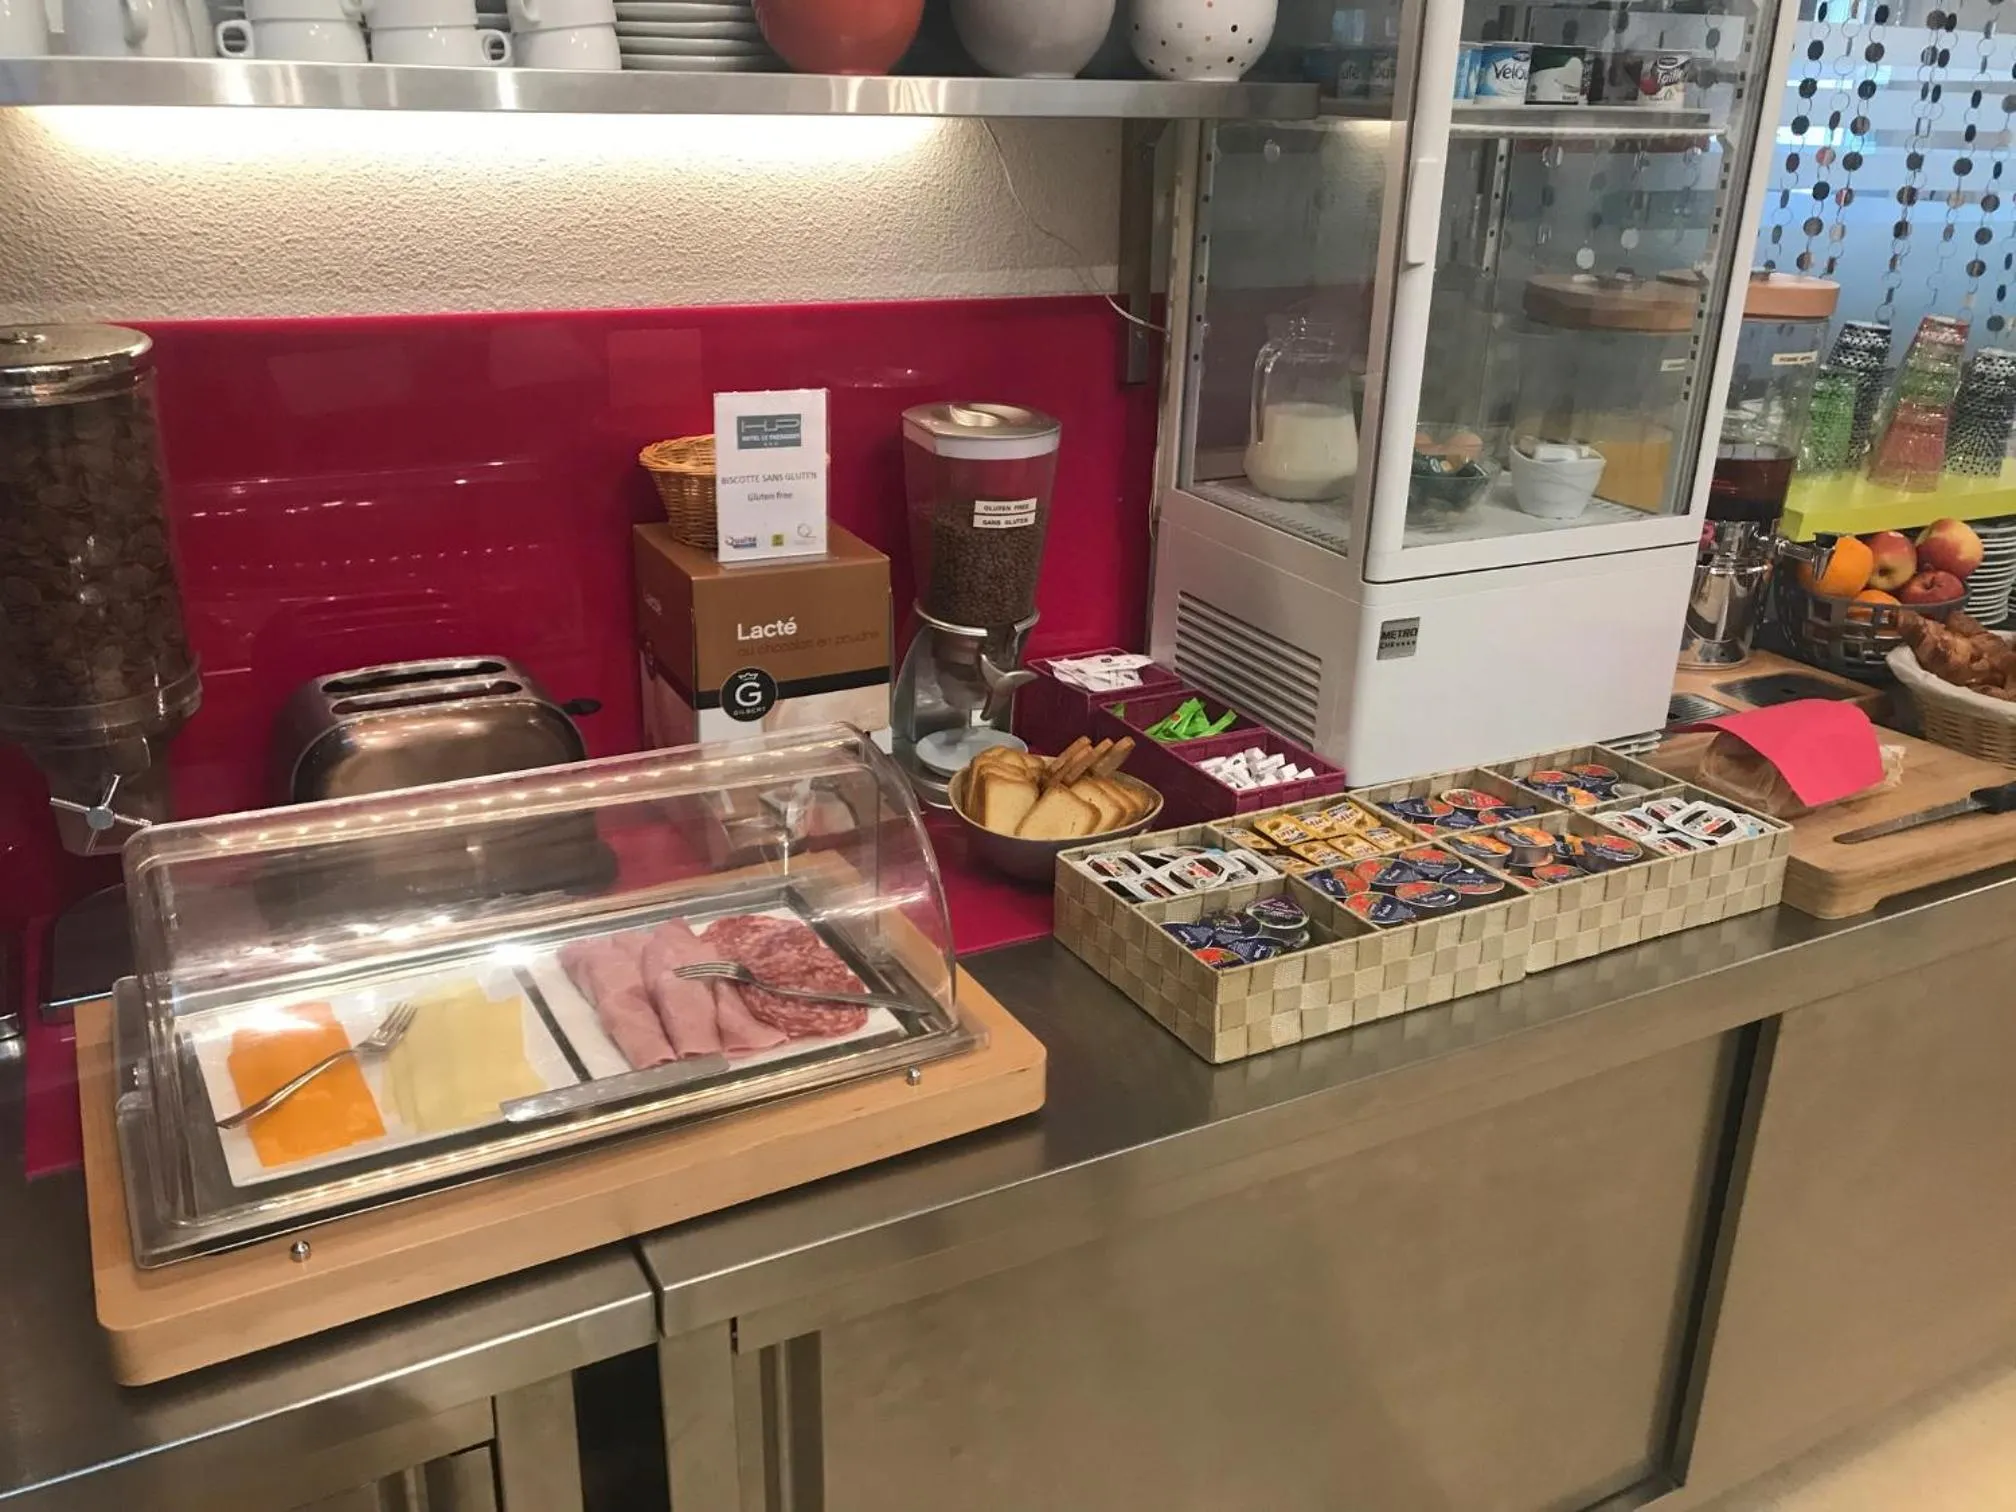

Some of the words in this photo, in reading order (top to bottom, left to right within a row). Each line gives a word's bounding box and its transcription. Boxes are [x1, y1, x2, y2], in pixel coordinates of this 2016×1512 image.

[721, 474, 760, 485] BISCOTTE
[762, 473, 783, 482] SANS
[785, 471, 817, 481] GLUTEN
[747, 491, 775, 502] Gluten
[983, 504, 1011, 512] GLUTEN
[737, 617, 797, 641] Lacté
[1380, 628, 1418, 640] METRO
[757, 637, 814, 656] chocolat
[816, 636, 832, 648] en
[835, 630, 880, 646] poudre
[734, 681, 763, 707] G
